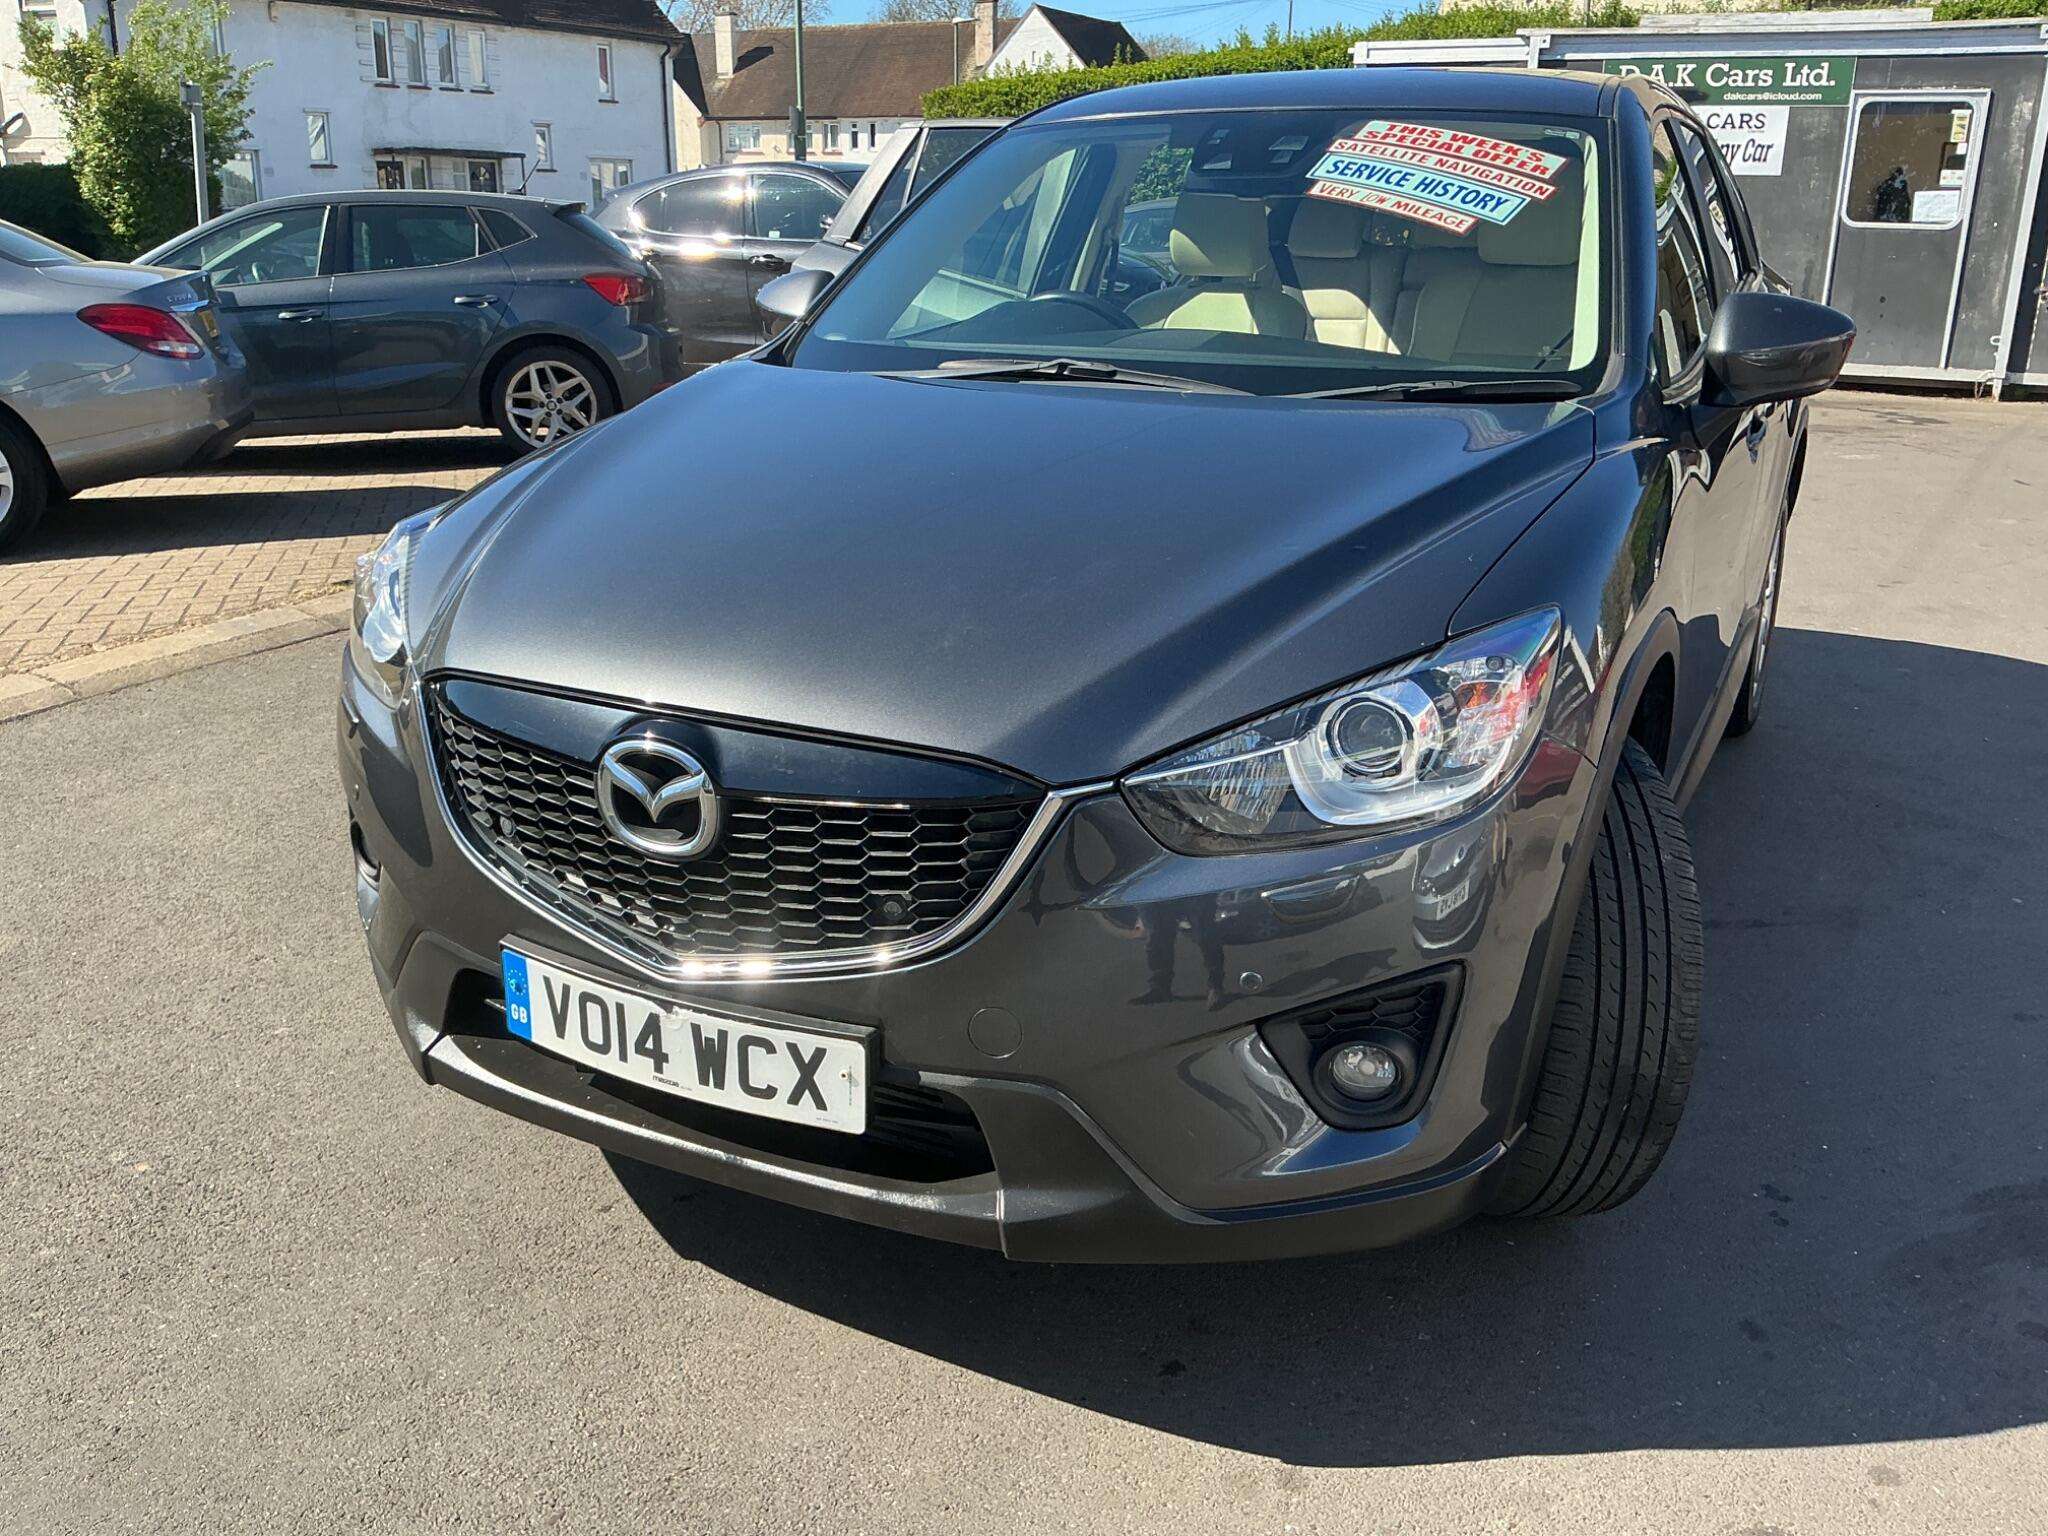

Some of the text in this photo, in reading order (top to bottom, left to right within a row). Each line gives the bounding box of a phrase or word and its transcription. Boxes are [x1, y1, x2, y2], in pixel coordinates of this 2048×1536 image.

[1706, 62, 1773, 87] Cars
[1783, 62, 1835, 87] Ltd.
[1723, 91, 1822, 101] dakcars@icloud.com
[1706, 113, 1767, 129] CARS
[1363, 131, 1550, 175] SPECIAL OFFER
[1386, 124, 1545, 162] THIS WEEK'S
[1719, 138, 1774, 168] ny Car
[1326, 160, 1511, 213] SERVICE HISTORY
[1334, 141, 1549, 196] SATELLITE NAVIGATION
[1319, 183, 1469, 229] VERY LOW MILEAGE
[511, 1004, 528, 1023] GB
[543, 975, 669, 1075] VO14
[690, 1022, 828, 1111] WCX
